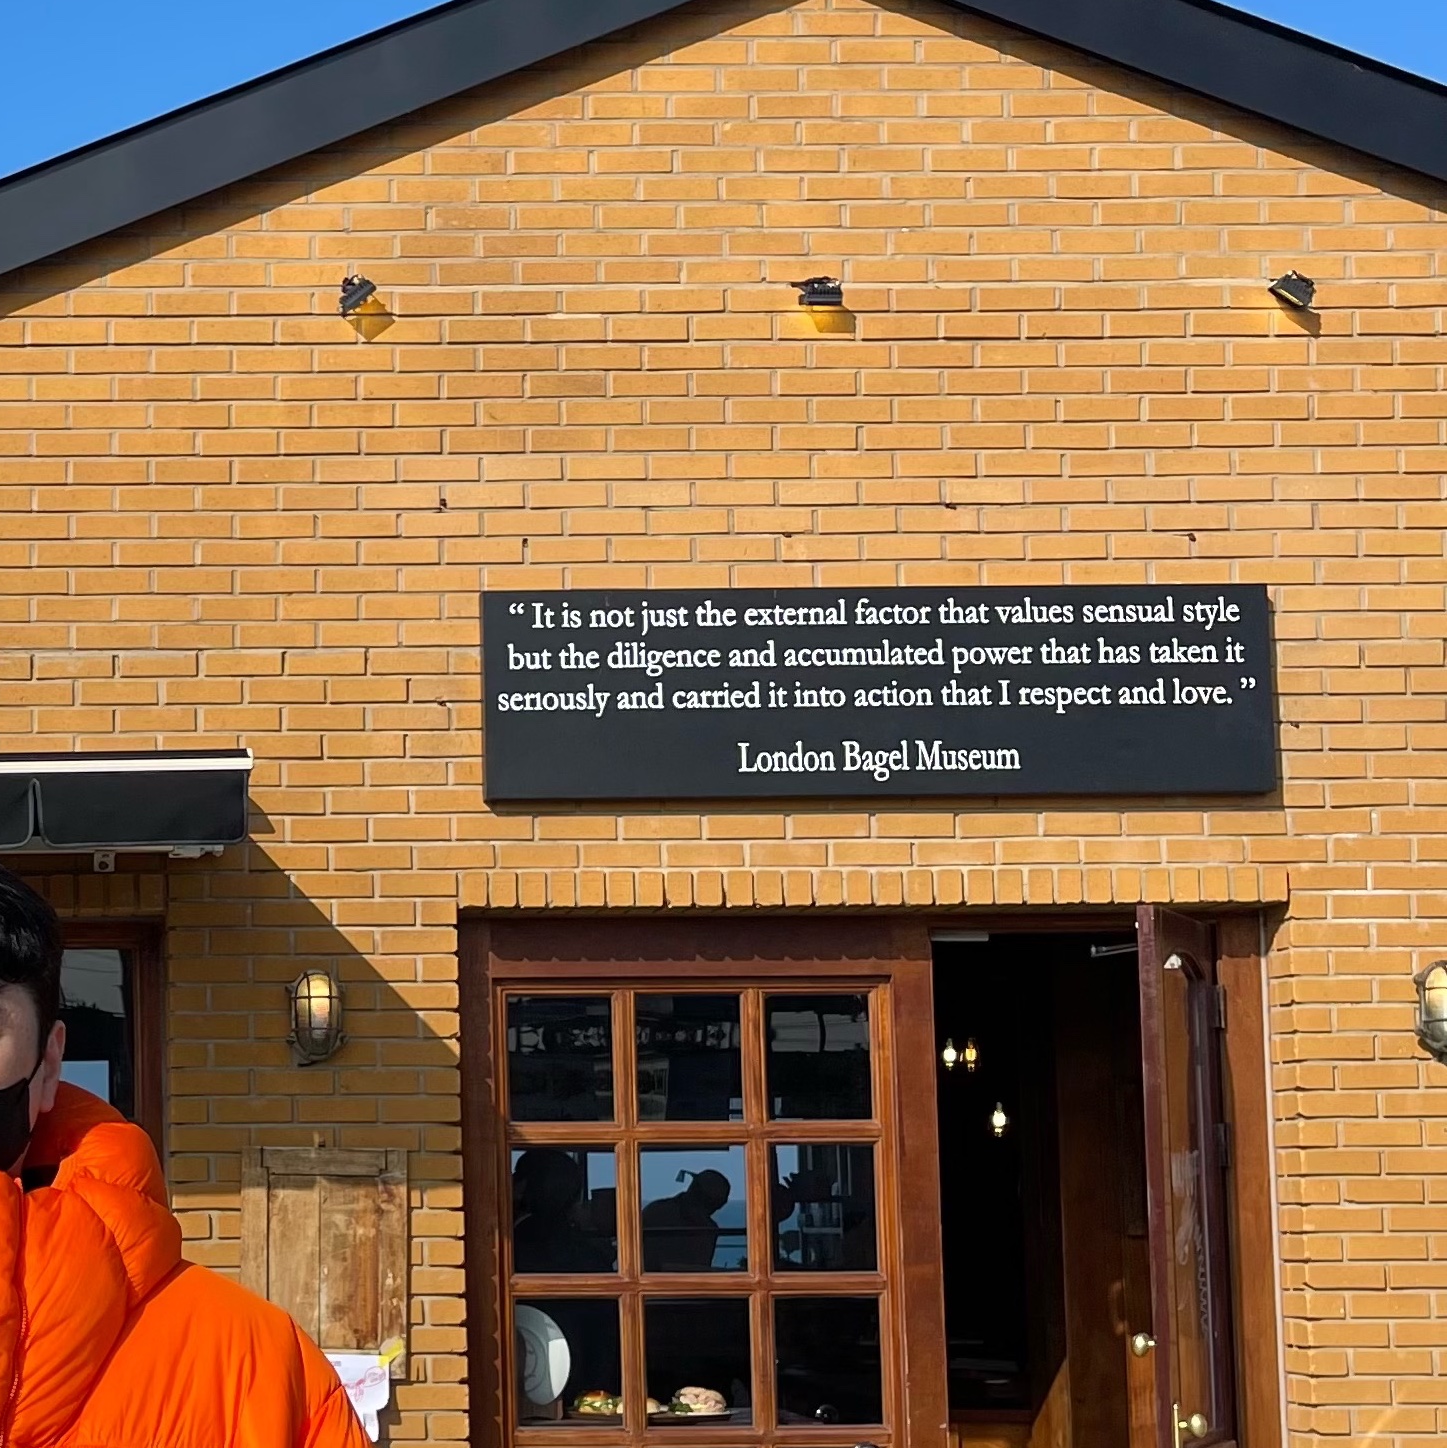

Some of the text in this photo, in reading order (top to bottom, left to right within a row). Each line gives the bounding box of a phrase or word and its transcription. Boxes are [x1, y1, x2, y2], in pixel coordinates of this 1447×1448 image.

[531, 602, 555, 629] It
[561, 602, 582, 628] is
[589, 606, 635, 628] not
[641, 601, 689, 636] just
[695, 600, 737, 627] the
[743, 599, 848, 627] external
[855, 598, 932, 625] factor
[938, 597, 990, 624] that
[995, 596, 1074, 624] values
[1082, 595, 1175, 623] sensual
[1183, 596, 1241, 631] style
[507, 637, 1245, 677] but the diligence and accumulated power that has taken it
[498, 683, 611, 718] seriously
[617, 682, 664, 710] and
[672, 681, 761, 709] carried
[768, 682, 788, 708] it
[793, 681, 846, 708] into
[853, 680, 933, 707] action
[940, 680, 992, 706] that
[998, 679, 1011, 705] I
[1018, 685, 1112, 714] respect
[1118, 678, 1166, 705] and
[737, 740, 1021, 781] London Bagel Museum
